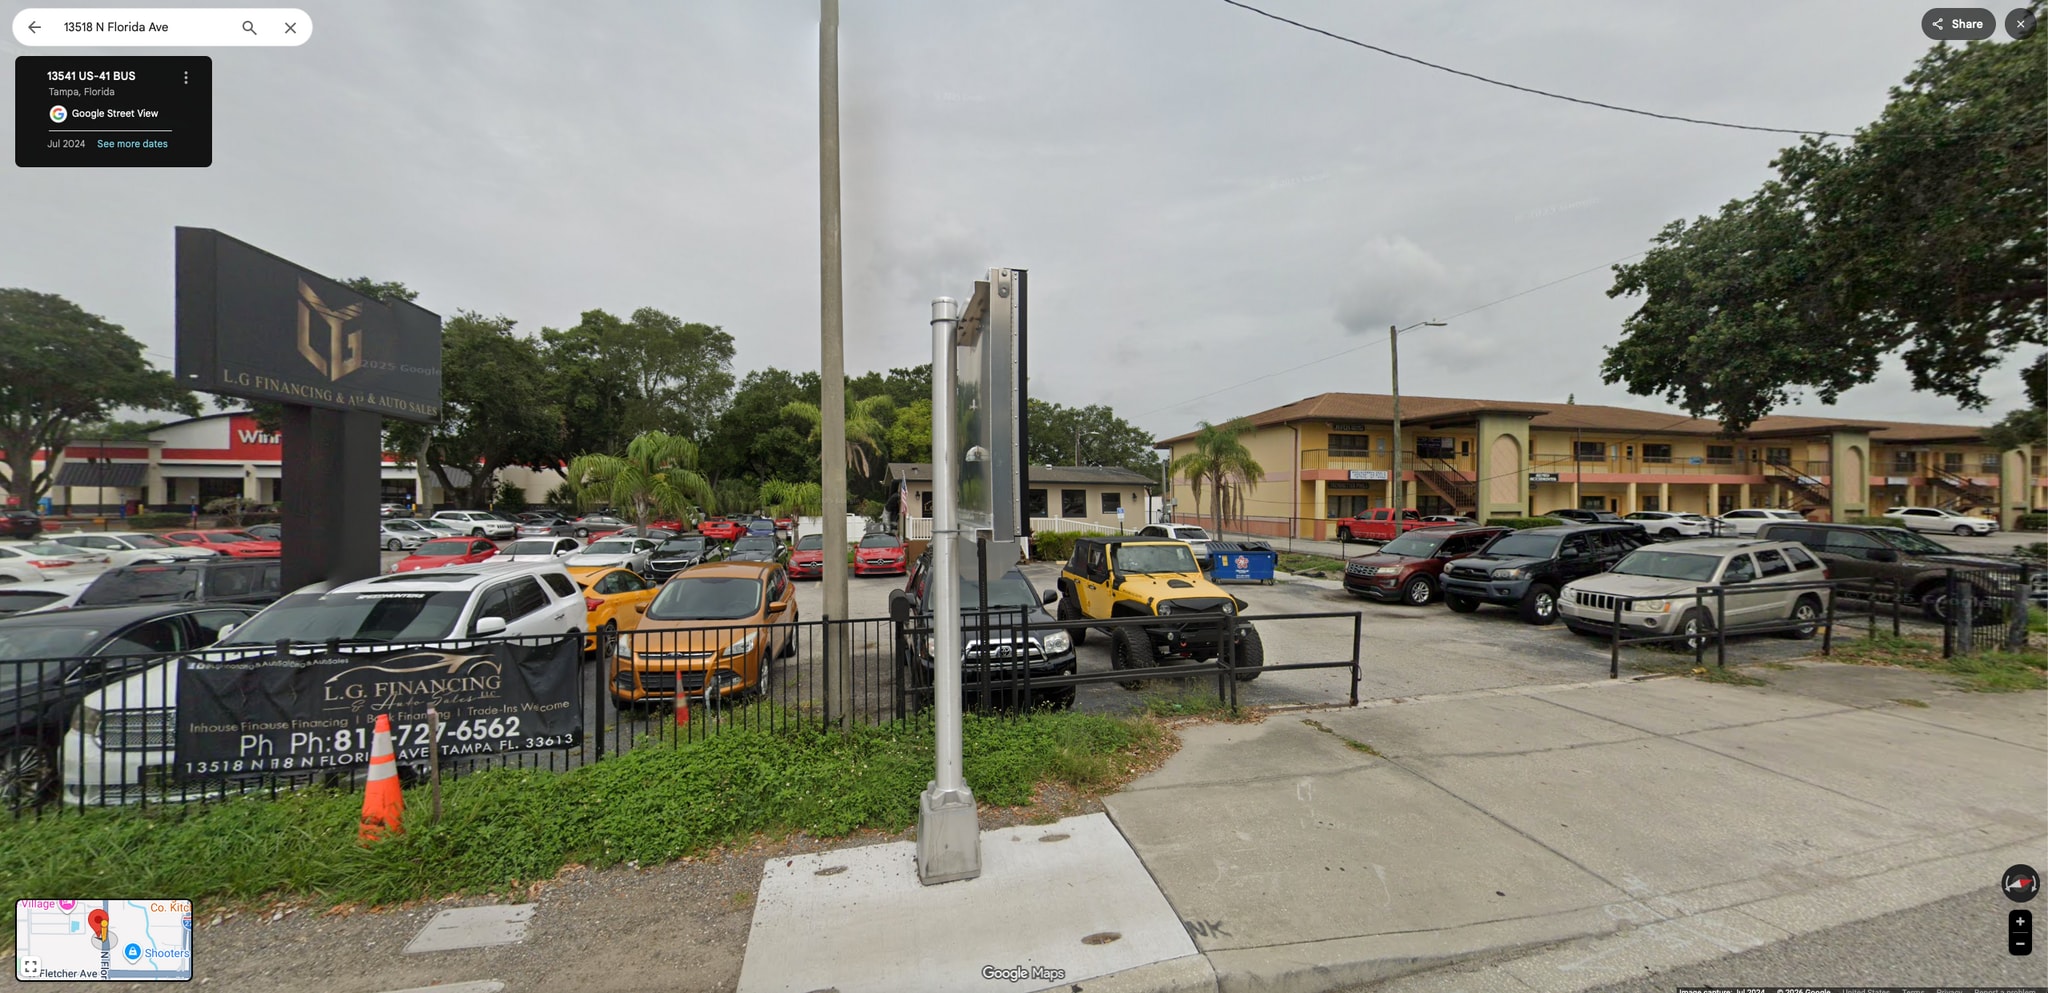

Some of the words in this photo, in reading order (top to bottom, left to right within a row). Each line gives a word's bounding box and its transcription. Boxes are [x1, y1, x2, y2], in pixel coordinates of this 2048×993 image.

[223, 369, 250, 386] L.G
[255, 375, 333, 402] FINANCING
[336, 392, 345, 404] &
[367, 393, 376, 405] &
[379, 395, 407, 410] AUTO
[409, 401, 438, 417] SALES
[324, 683, 368, 701] L.G.
[375, 675, 502, 697] FINANCING
[371, 692, 425, 711] Auto
[190, 722, 239, 733] Inhouse
[468, 702, 518, 715] Trade-Ins
[186, 760, 244, 774] 13518
[251, 760, 263, 771] N
[301, 757, 314, 768] N
[441, 742, 493, 756] TAMPA
[500, 740, 520, 751] FL.
[526, 734, 574, 749] 33613
[241, 734, 273, 757] Ph
